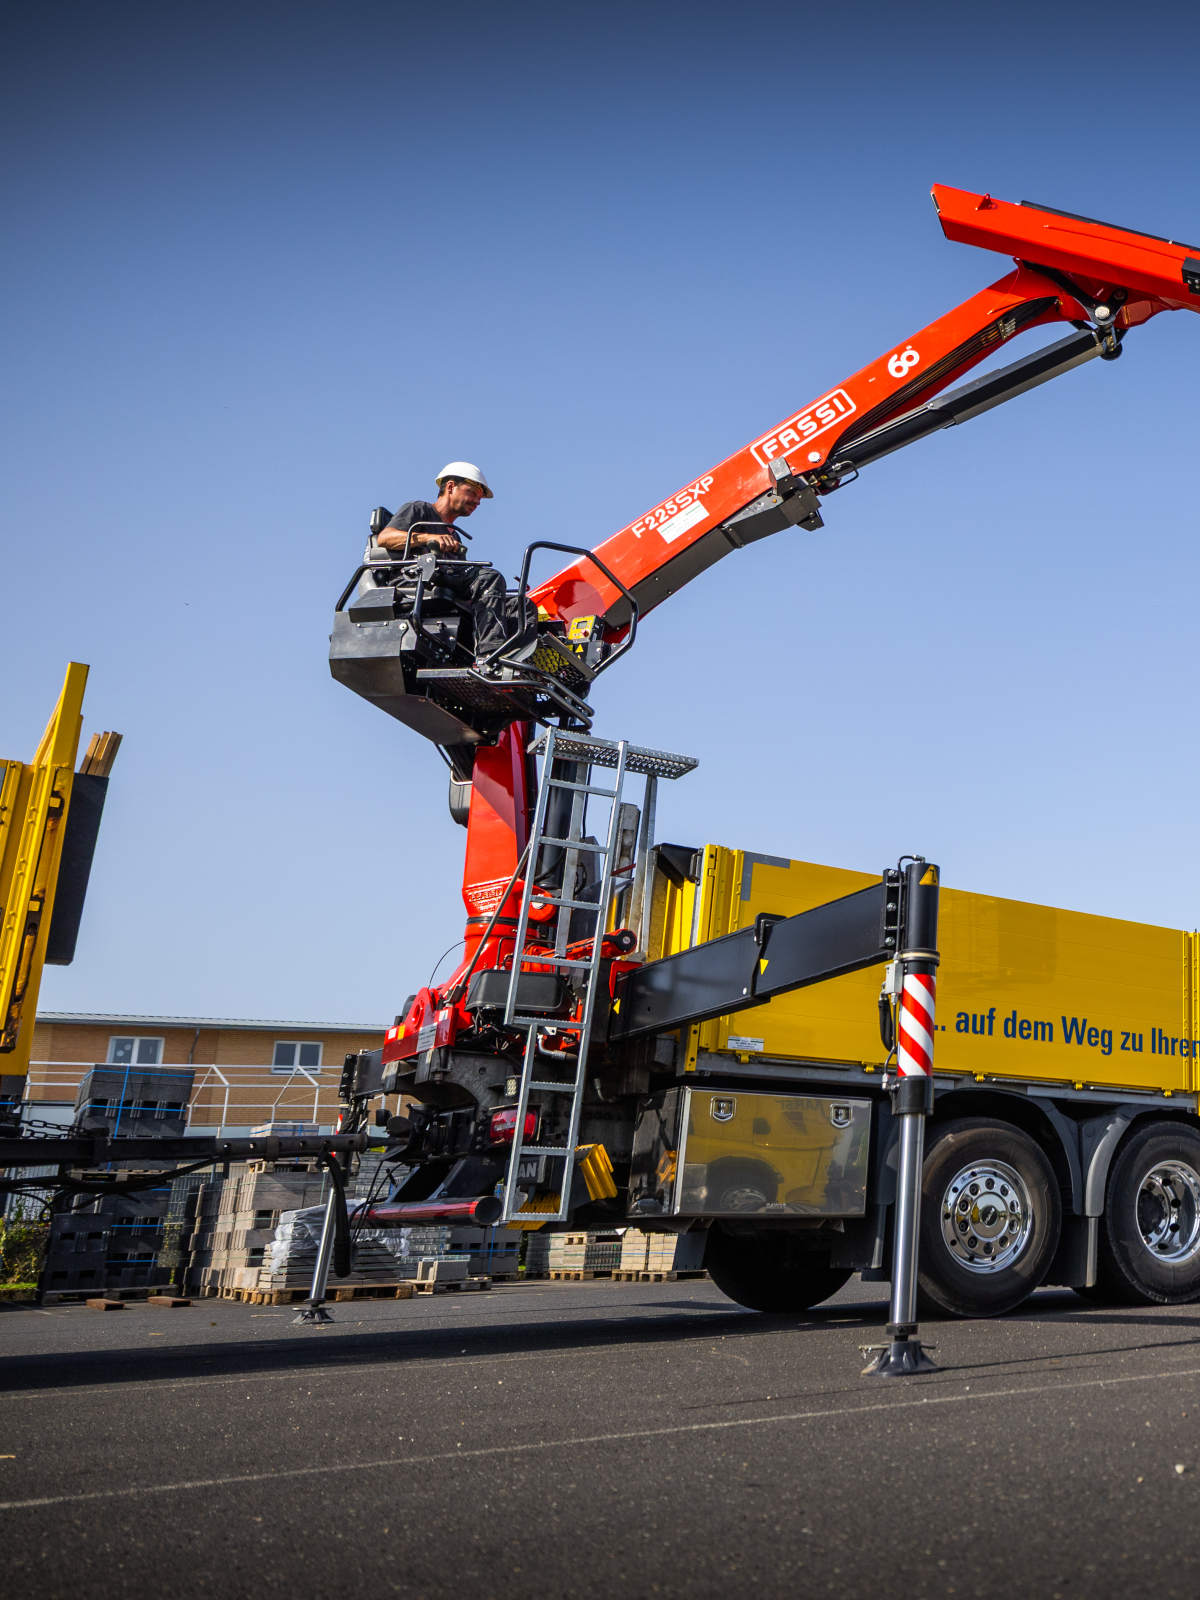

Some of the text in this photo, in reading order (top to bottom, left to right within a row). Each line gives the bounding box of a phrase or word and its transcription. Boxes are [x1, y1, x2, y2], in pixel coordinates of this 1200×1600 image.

[761, 398, 848, 461] FASSI
[631, 475, 715, 539] F225SXP
[955, 1008, 996, 1036] auf
[1003, 1010, 1053, 1042] dem
[1061, 1016, 1113, 1055] Weg
[1120, 1030, 1144, 1052] zu
